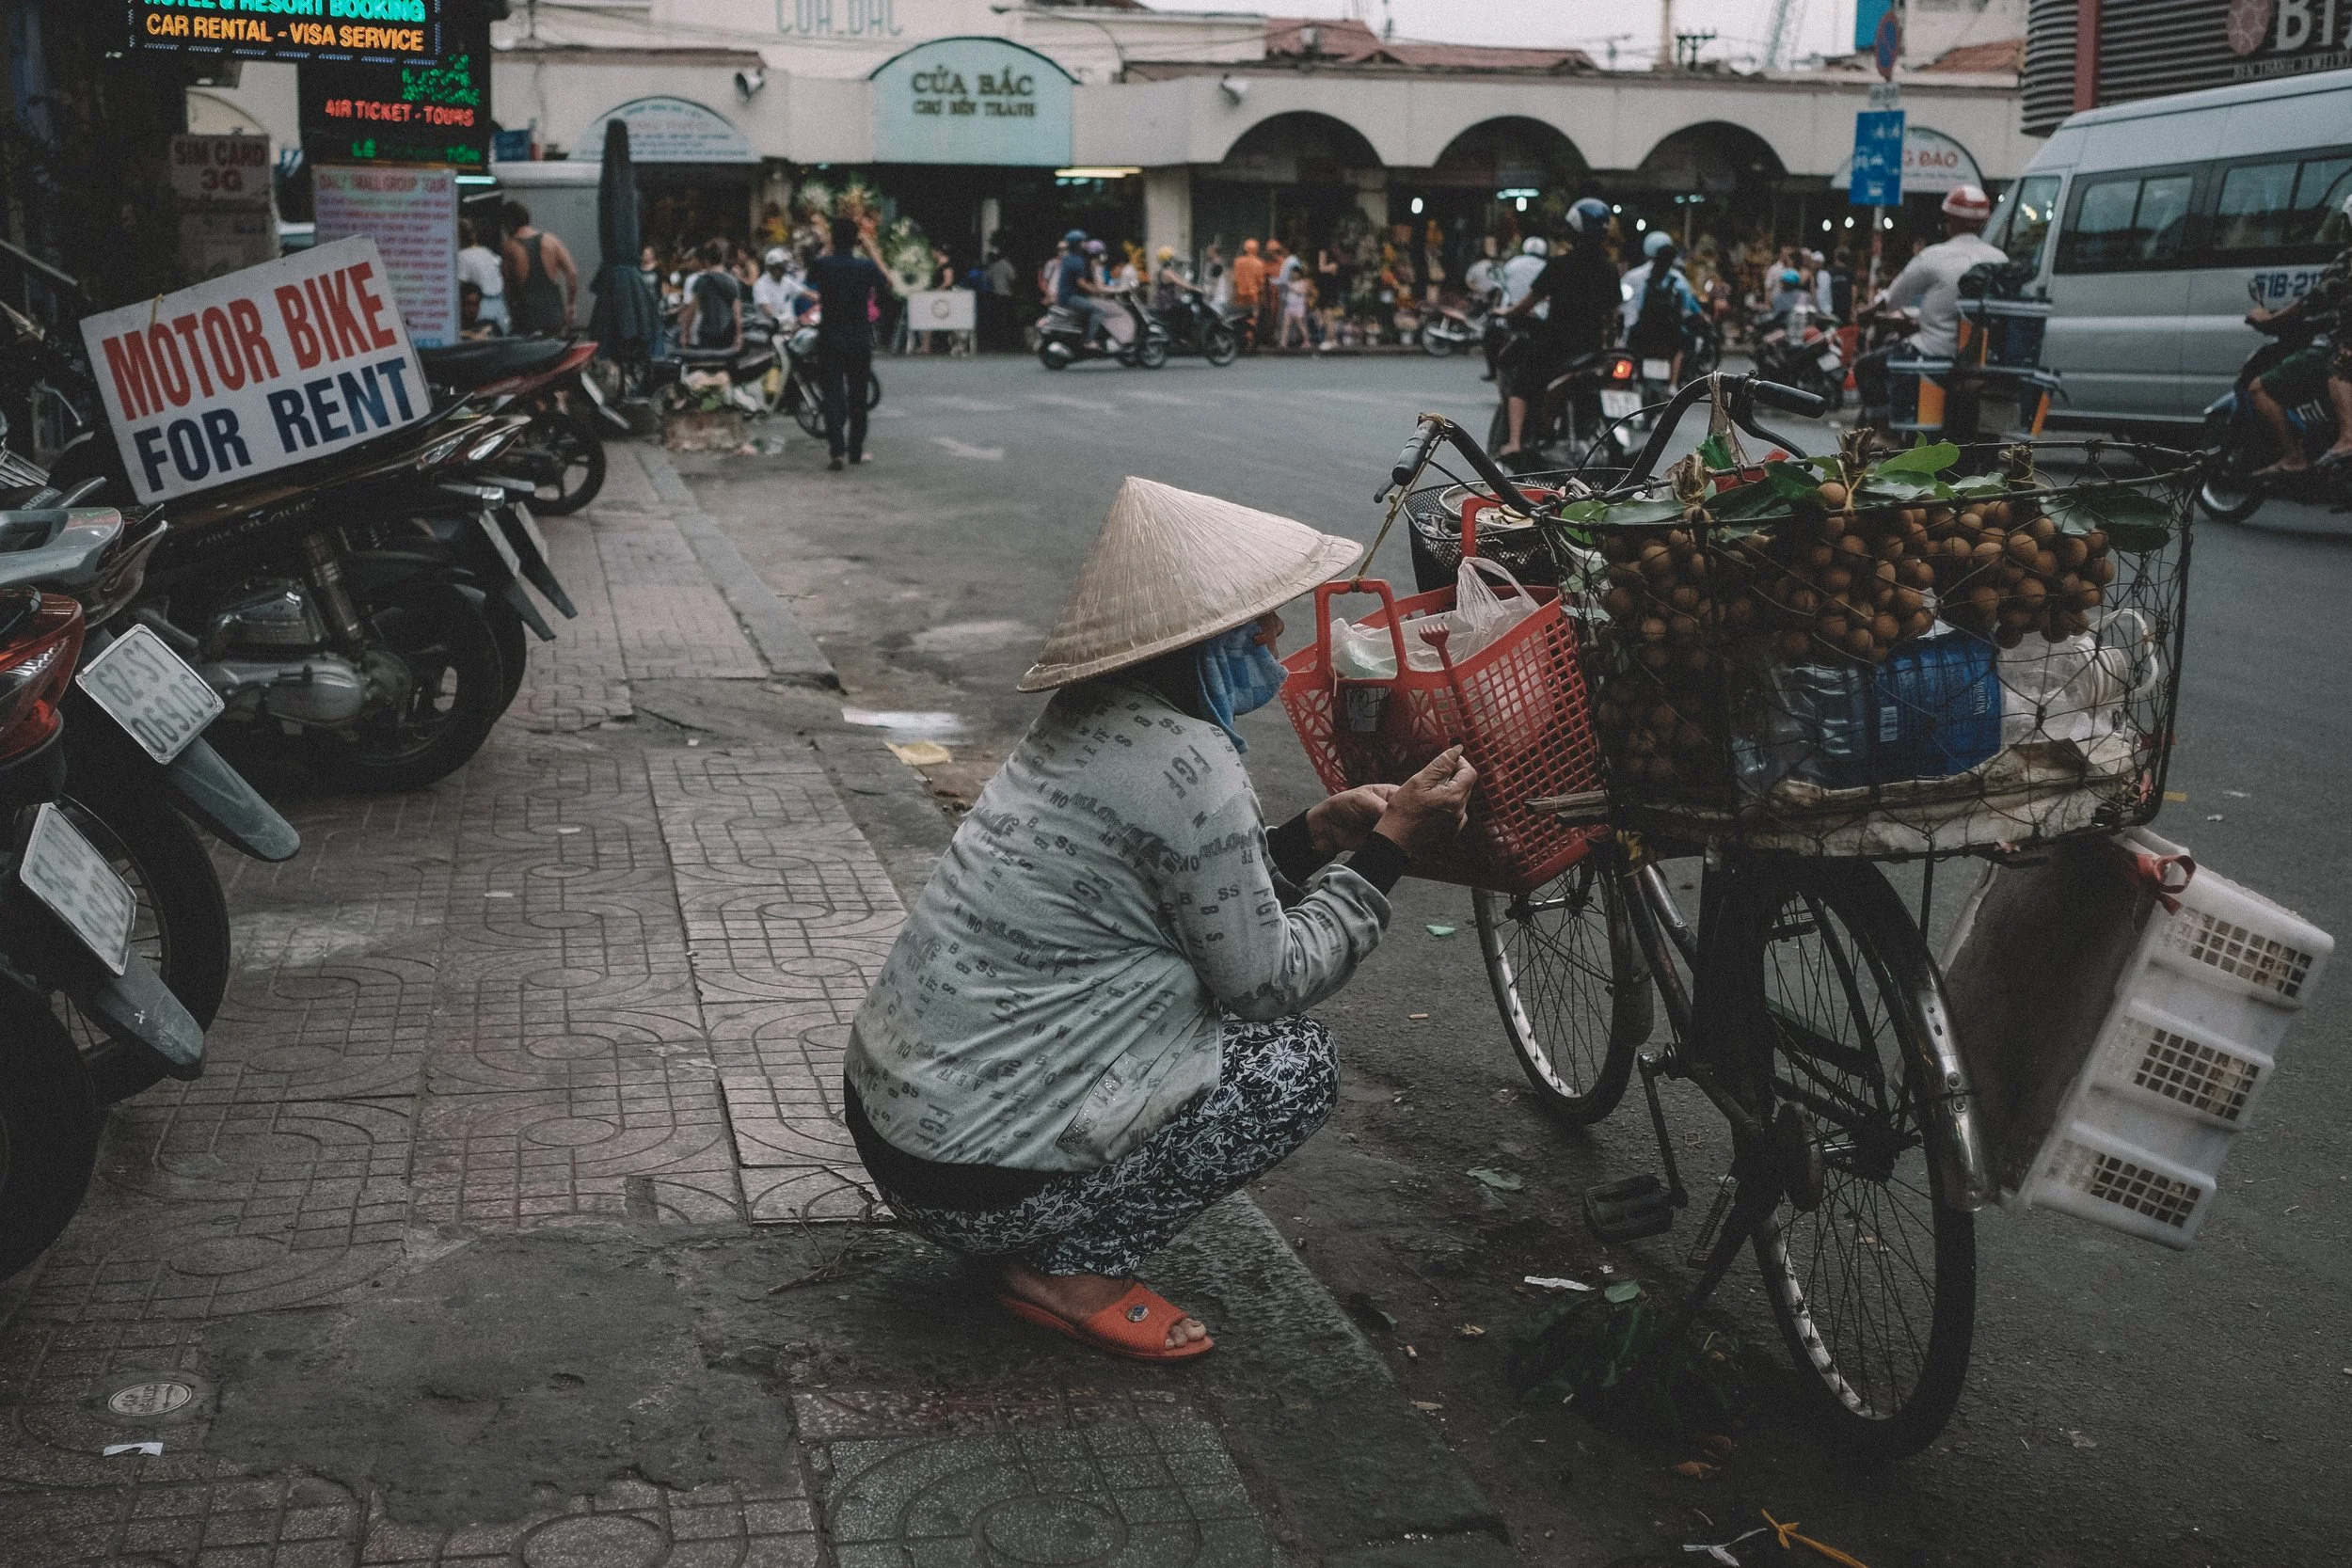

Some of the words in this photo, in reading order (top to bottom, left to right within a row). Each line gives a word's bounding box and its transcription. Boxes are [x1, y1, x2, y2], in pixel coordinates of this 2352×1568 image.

[329, 0, 426, 23] BOOKING
[146, 12, 189, 37] CAR
[194, 16, 274, 42] RENTAL
[289, 22, 337, 45] VISA
[339, 24, 424, 52] SERVICE
[355, 101, 413, 122] TICKET
[423, 104, 475, 127] TOURS
[215, 140, 266, 167] CARD
[201, 168, 244, 192] 3G
[102, 297, 280, 422] MOTOR
[274, 261, 398, 371] BIKE
[134, 407, 252, 494] FOR
[266, 356, 415, 454] RENT
